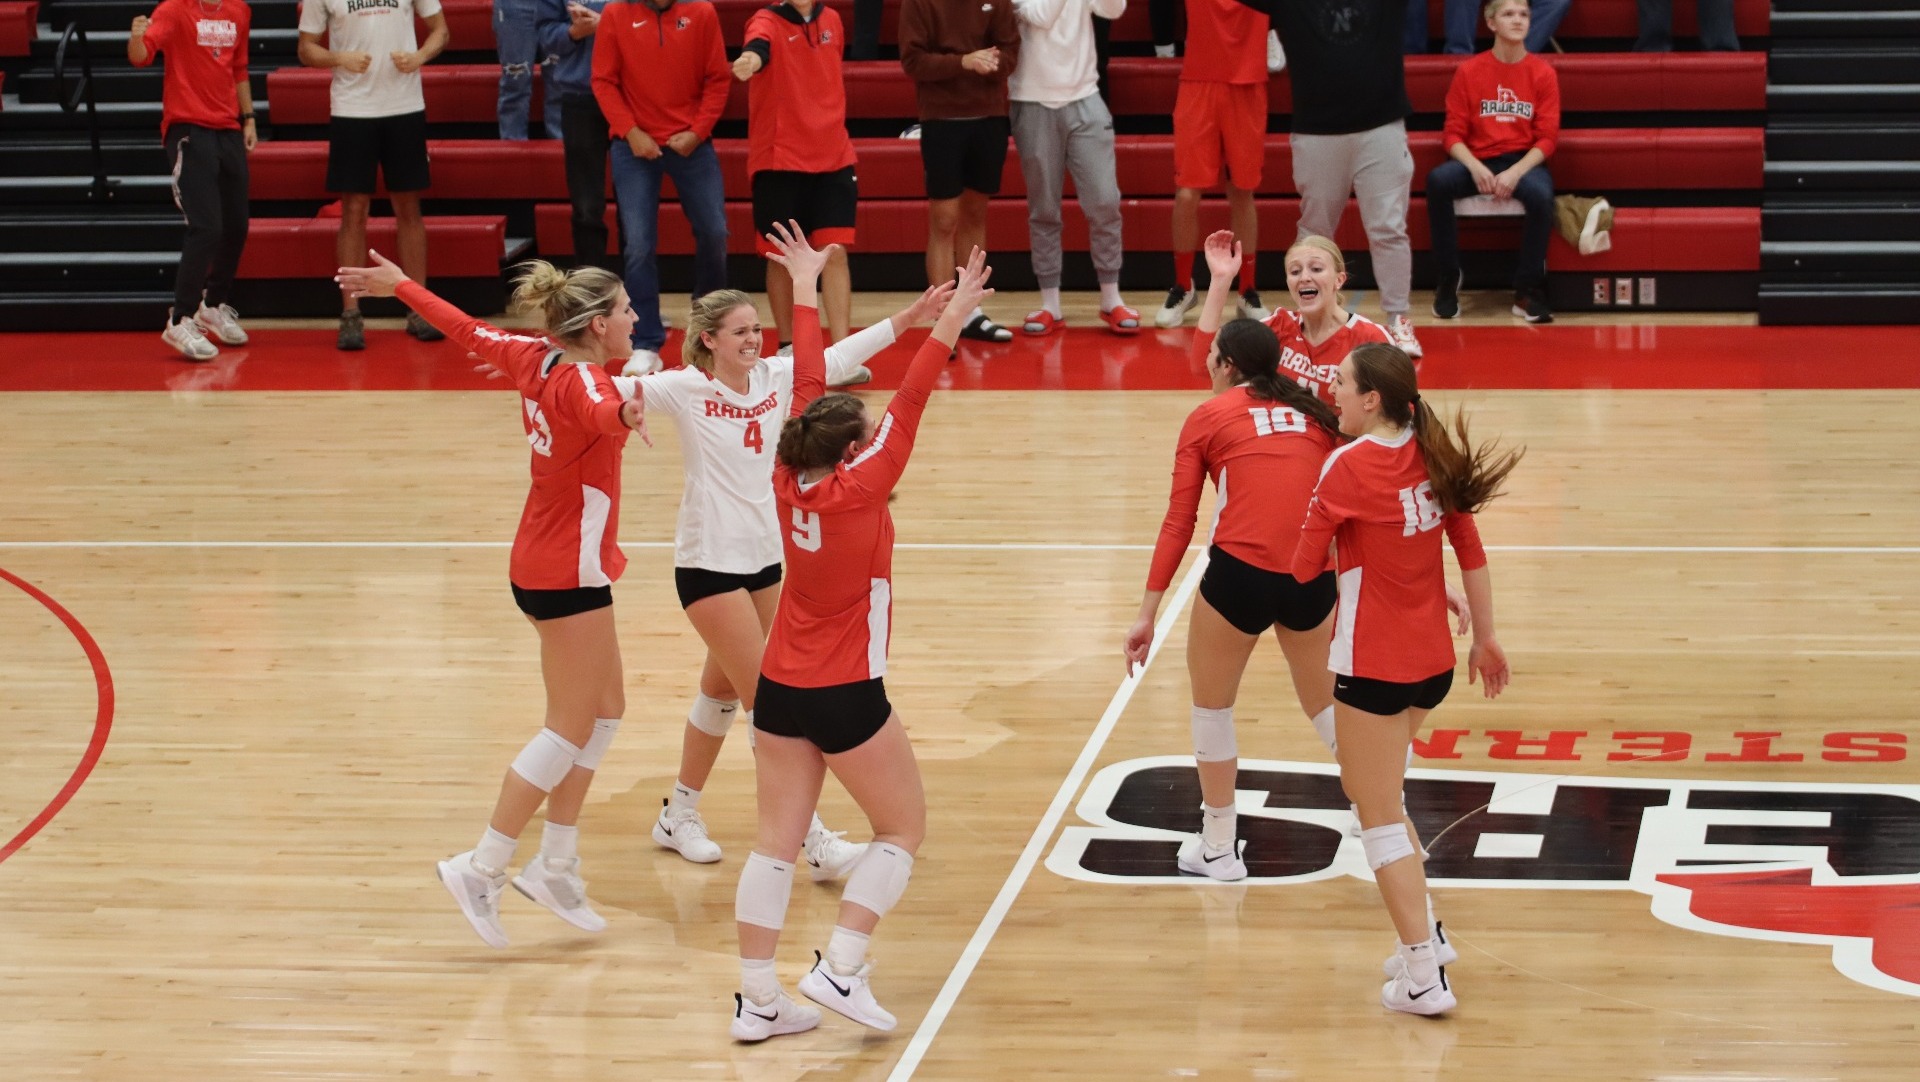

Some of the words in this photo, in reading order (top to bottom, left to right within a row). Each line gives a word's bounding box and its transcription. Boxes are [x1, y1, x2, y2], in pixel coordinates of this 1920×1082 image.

[1279, 346, 1340, 384] RAIDER
[743, 420, 764, 455] 4
[1248, 406, 1307, 437] 10
[791, 506, 822, 553] 9
